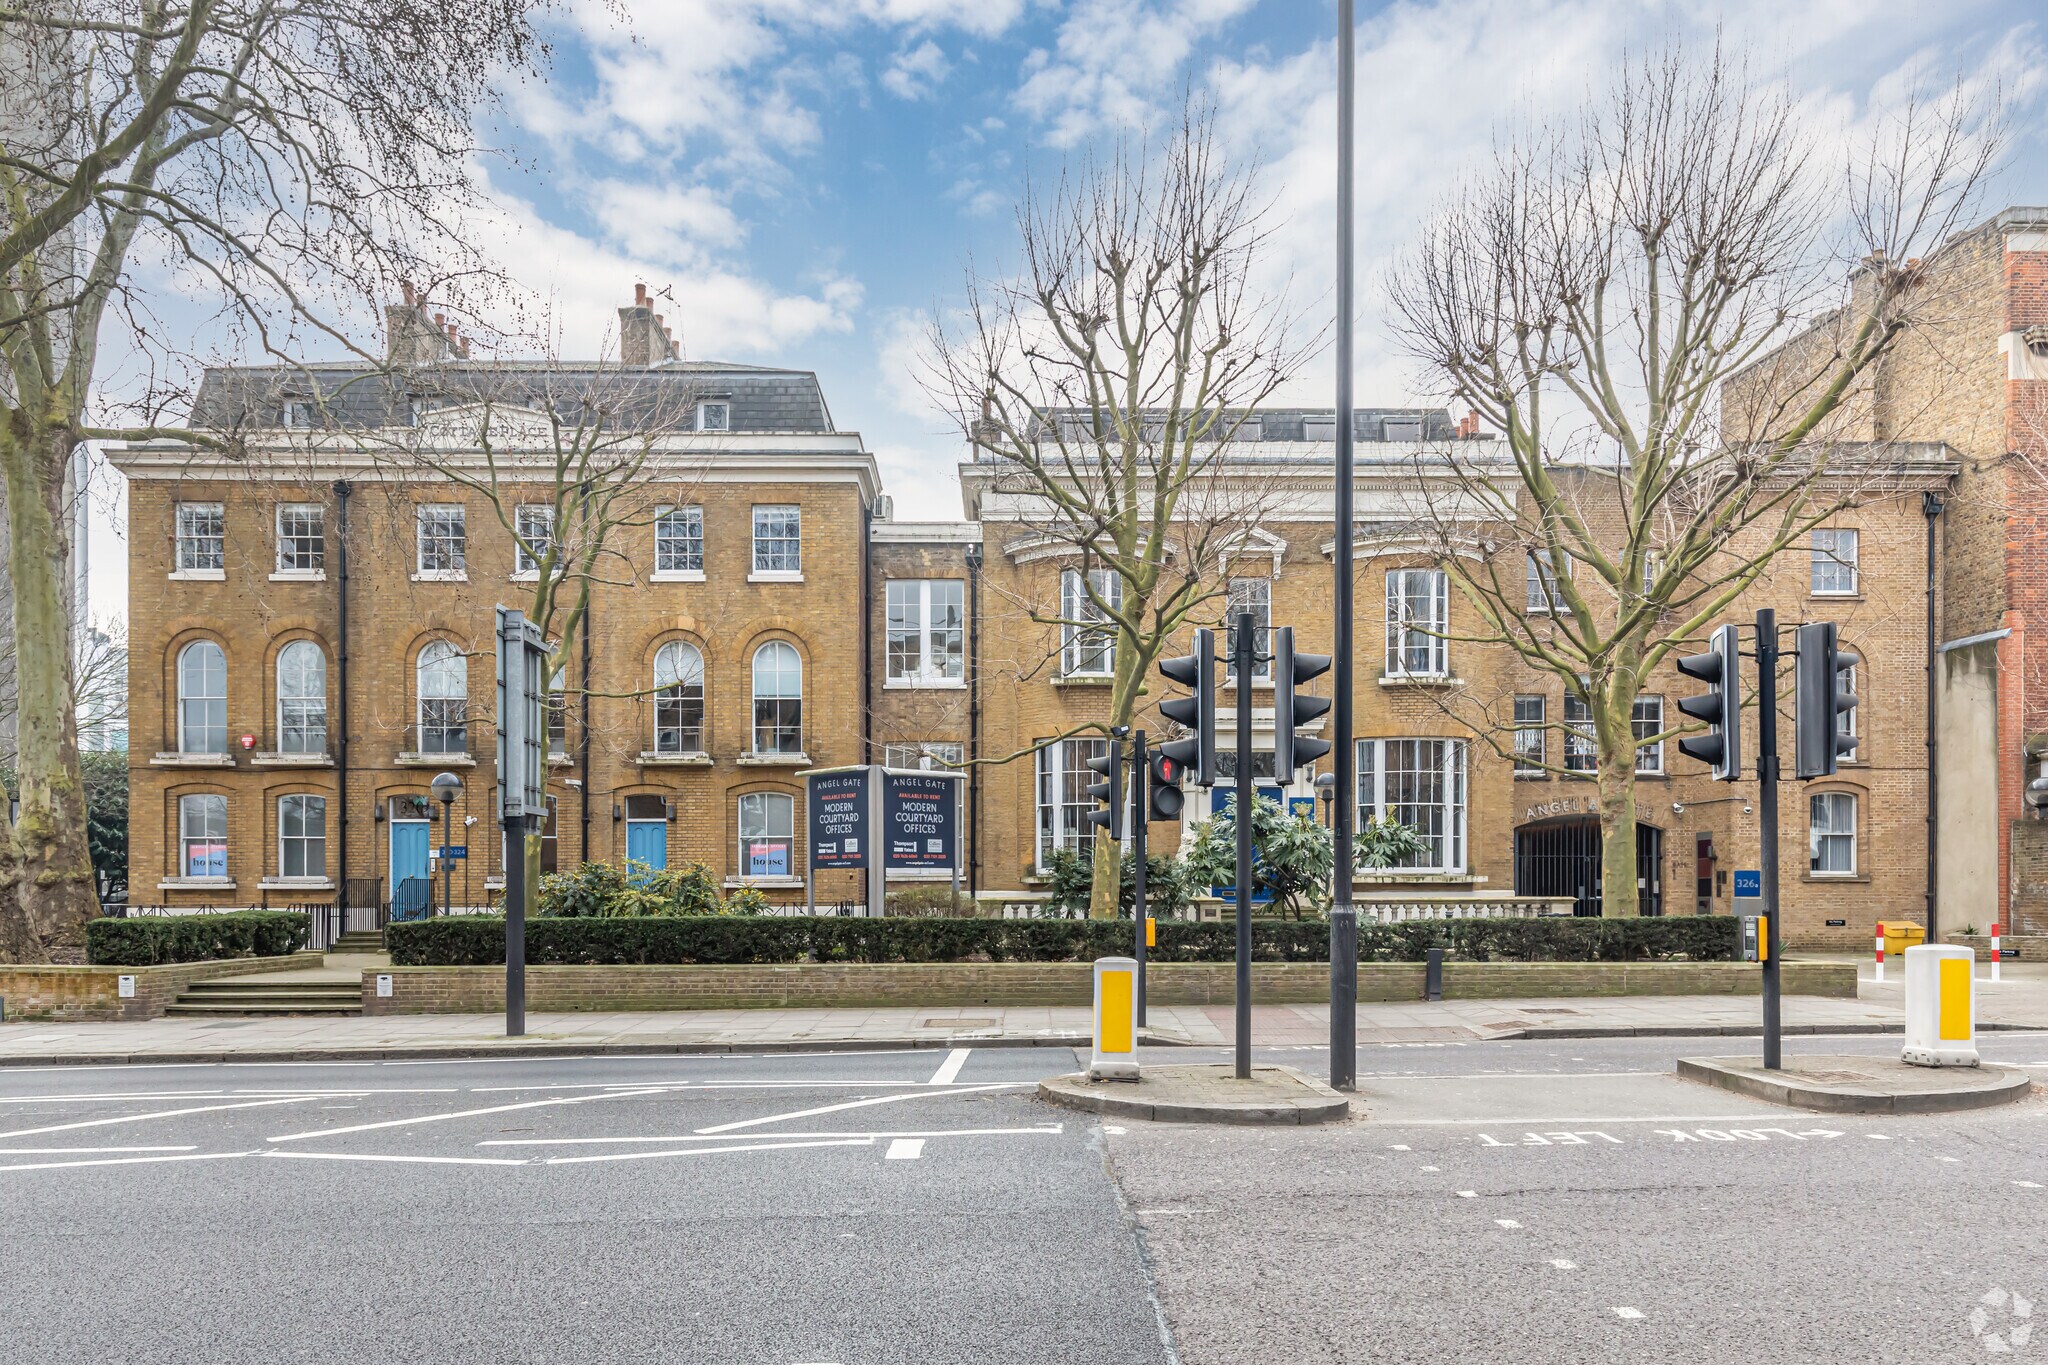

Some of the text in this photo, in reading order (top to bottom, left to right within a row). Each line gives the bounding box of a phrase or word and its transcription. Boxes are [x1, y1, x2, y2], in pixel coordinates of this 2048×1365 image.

[431, 425, 498, 437] COTTAE
[817, 778, 861, 790] ANGEL GATE
[925, 780, 946, 790] GATE
[824, 803, 853, 812] MODERN
[902, 802, 937, 813] MODERN
[1526, 800, 1579, 819] ANGEL
[819, 812, 860, 824] COURTYARD
[895, 812, 944, 823] COURTYARD
[825, 824, 852, 834] OFFICES
[903, 823, 937, 834] OFFICES
[1478, 1131, 1625, 1147] LEFT
[1654, 1127, 1809, 1142] LOOK
